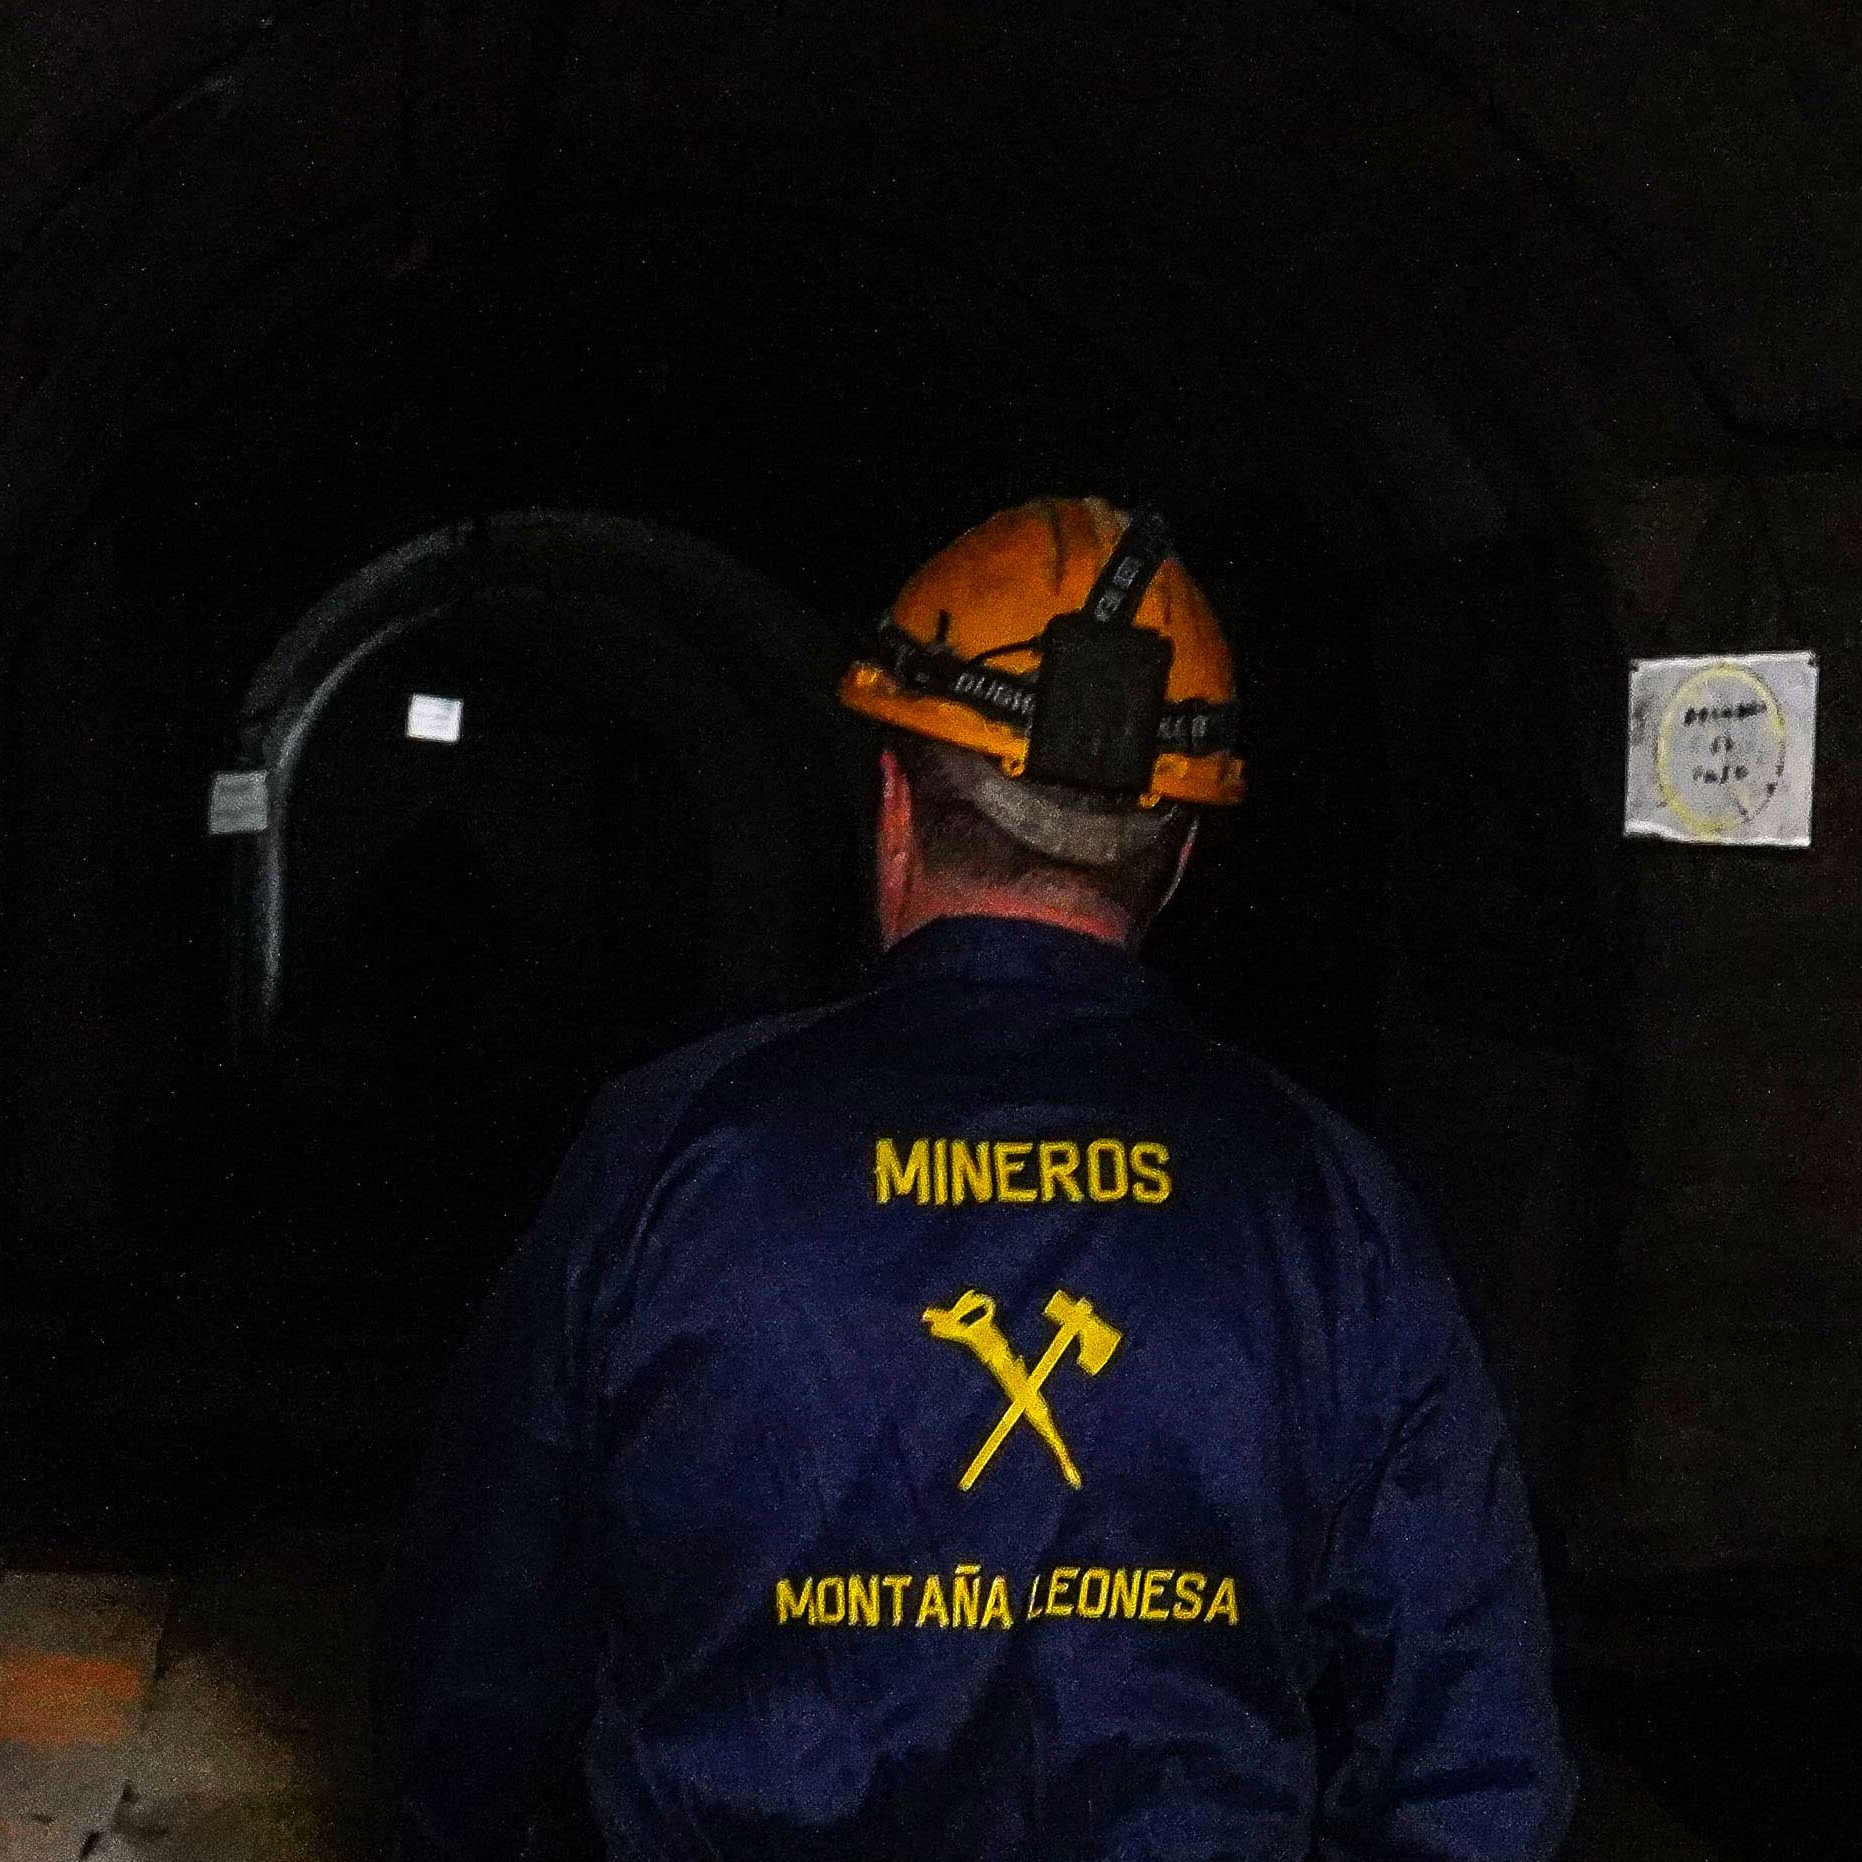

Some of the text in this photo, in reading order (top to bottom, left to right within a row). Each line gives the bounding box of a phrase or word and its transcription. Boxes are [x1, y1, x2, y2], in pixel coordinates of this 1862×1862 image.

[874, 1137, 1172, 1206] MINEROS
[775, 1563, 1240, 1629] MONTAÑA LEONESA
